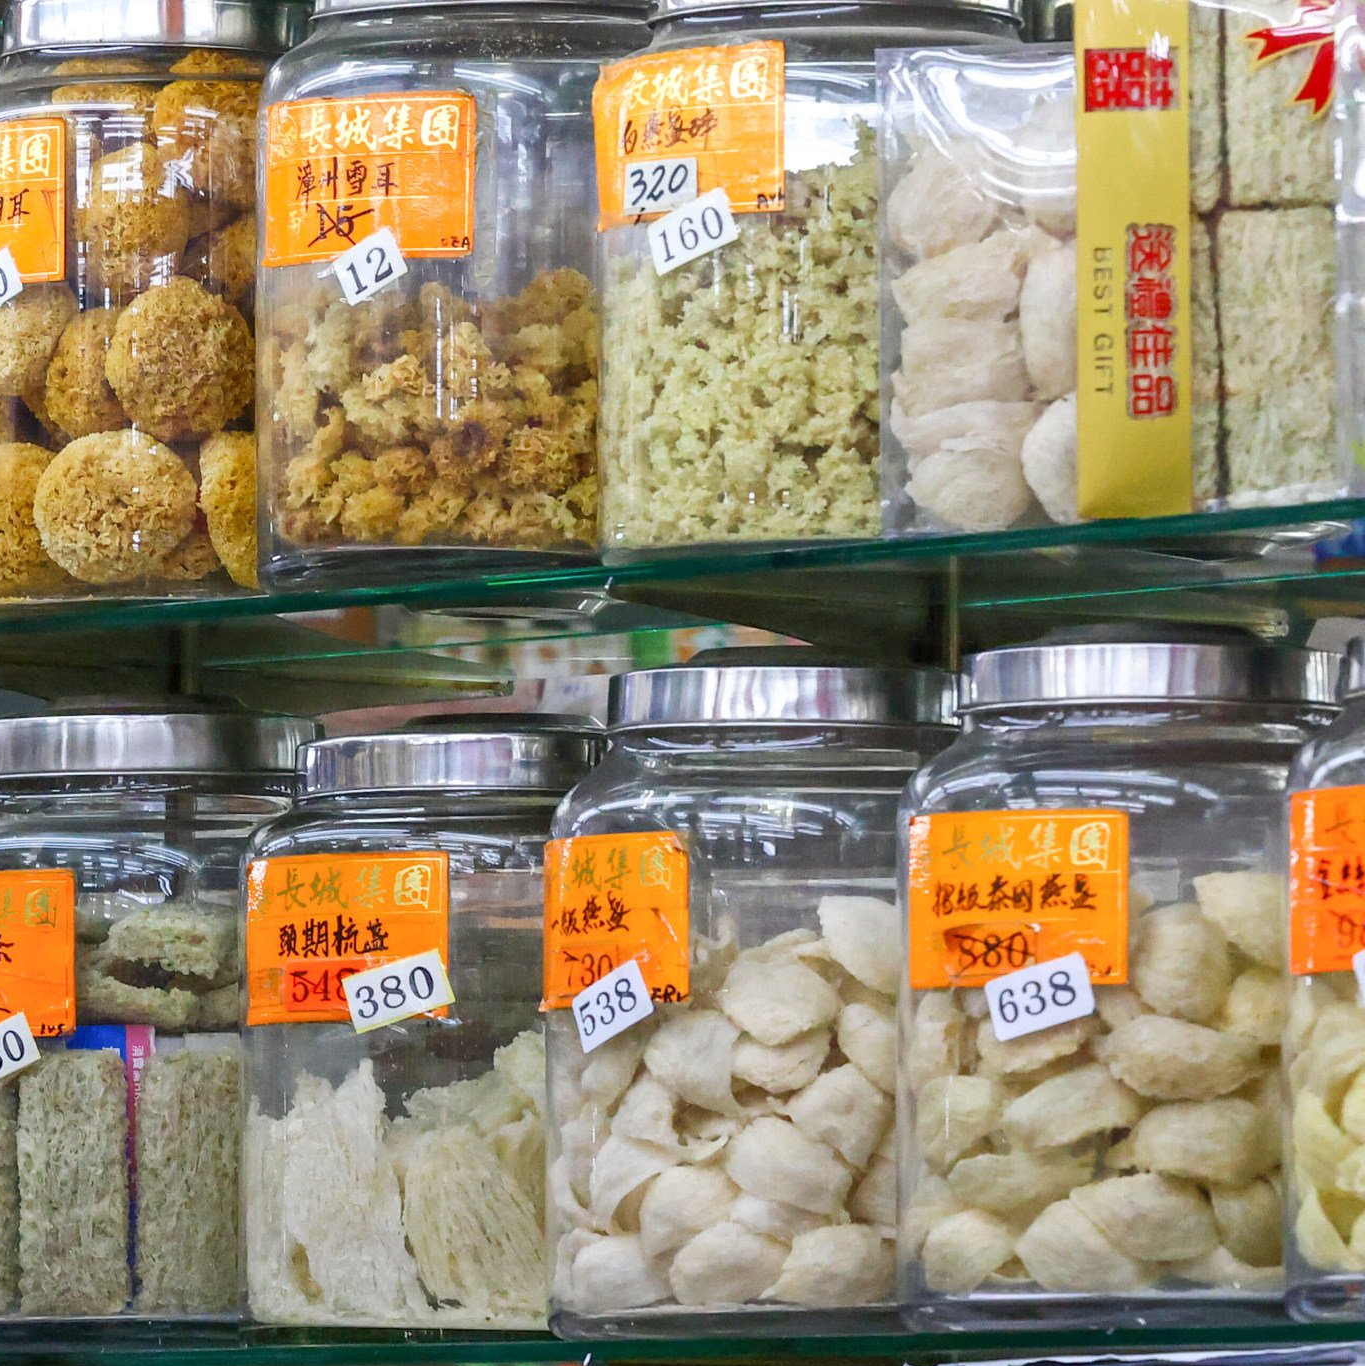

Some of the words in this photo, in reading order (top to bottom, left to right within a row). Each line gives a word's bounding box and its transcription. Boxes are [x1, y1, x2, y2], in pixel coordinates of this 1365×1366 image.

[300, 104, 459, 153] 長城集團
[630, 163, 688, 206] 320
[659, 206, 723, 262] 160
[346, 246, 393, 295] 12
[1091, 245, 1113, 318] BEST
[1127, 225, 1176, 418] 送禮佳品
[1092, 333, 1115, 396] GIFT
[277, 863, 433, 912] 長城集團
[354, 965, 435, 1019] 380
[578, 977, 638, 1037] 538
[998, 970, 1077, 1024] 638
